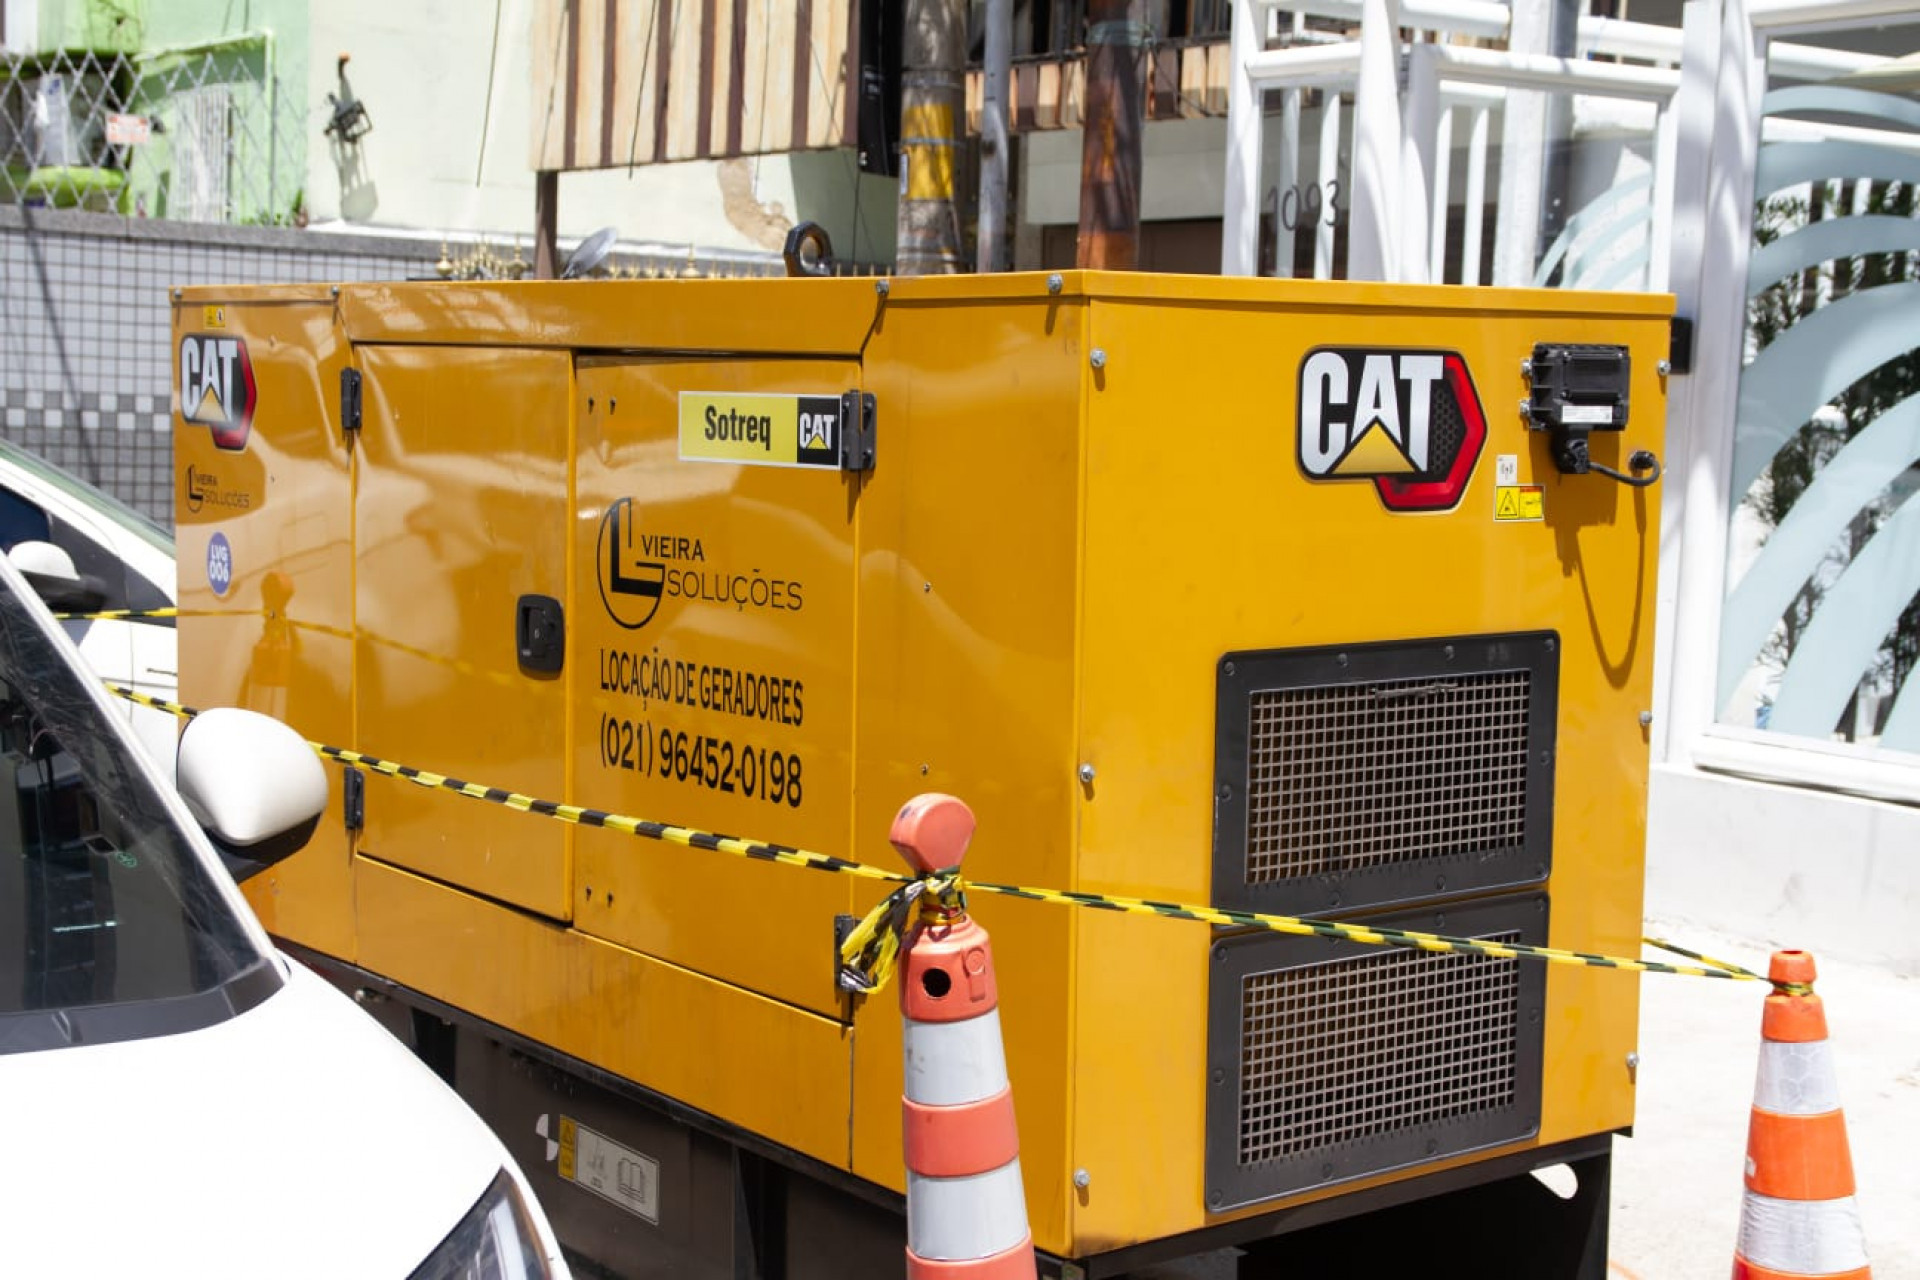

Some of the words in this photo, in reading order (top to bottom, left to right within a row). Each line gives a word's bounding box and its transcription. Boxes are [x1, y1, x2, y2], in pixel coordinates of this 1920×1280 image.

[181, 337, 238, 421] CAT
[705, 405, 771, 451] Sotreq
[800, 412, 835, 450] CAT
[1301, 352, 1444, 475] CAT
[641, 534, 705, 562] VIEIRA
[667, 568, 804, 612] SOLUÇÕES
[600, 646, 672, 711] LOCAÇÃO
[675, 661, 696, 706] DE
[700, 664, 804, 727] GERADORES
[601, 712, 653, 778] (021)
[659, 728, 803, 808] 96452-0198
